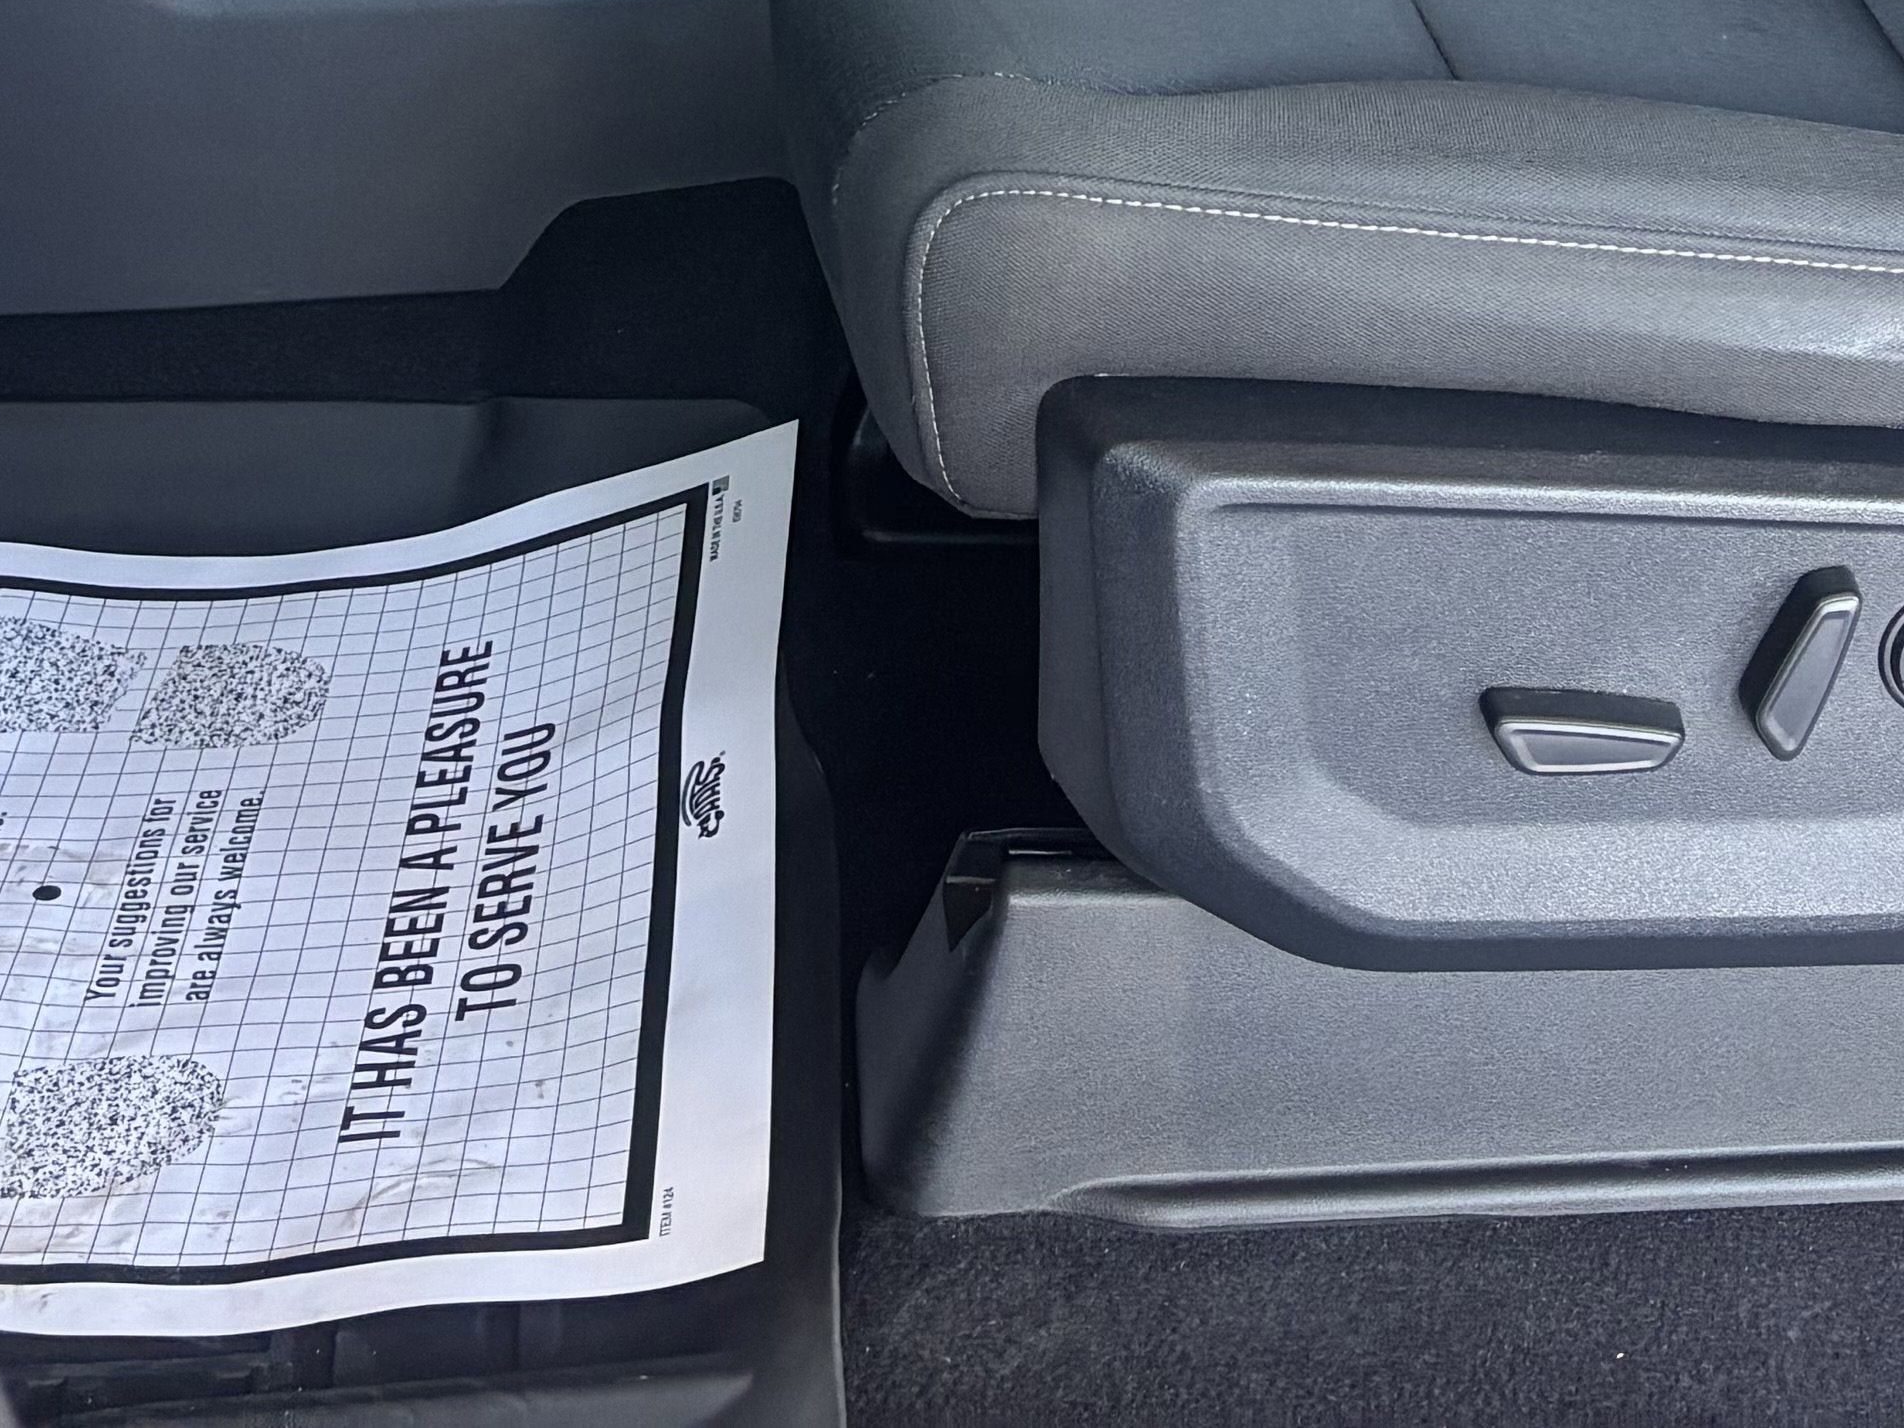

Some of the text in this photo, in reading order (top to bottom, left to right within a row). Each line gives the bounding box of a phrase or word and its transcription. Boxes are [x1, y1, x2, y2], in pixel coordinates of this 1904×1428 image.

[709, 539, 721, 562] MADE
[83, 798, 177, 1002] Your suggestions for
[128, 789, 222, 1007] improving our service
[185, 790, 266, 1001] are always welcome.
[338, 640, 494, 1144] IT HAS BEEN A PLEASURE
[454, 722, 556, 1022] TO SERVE YOU
[659, 1211, 672, 1237] ITEM
